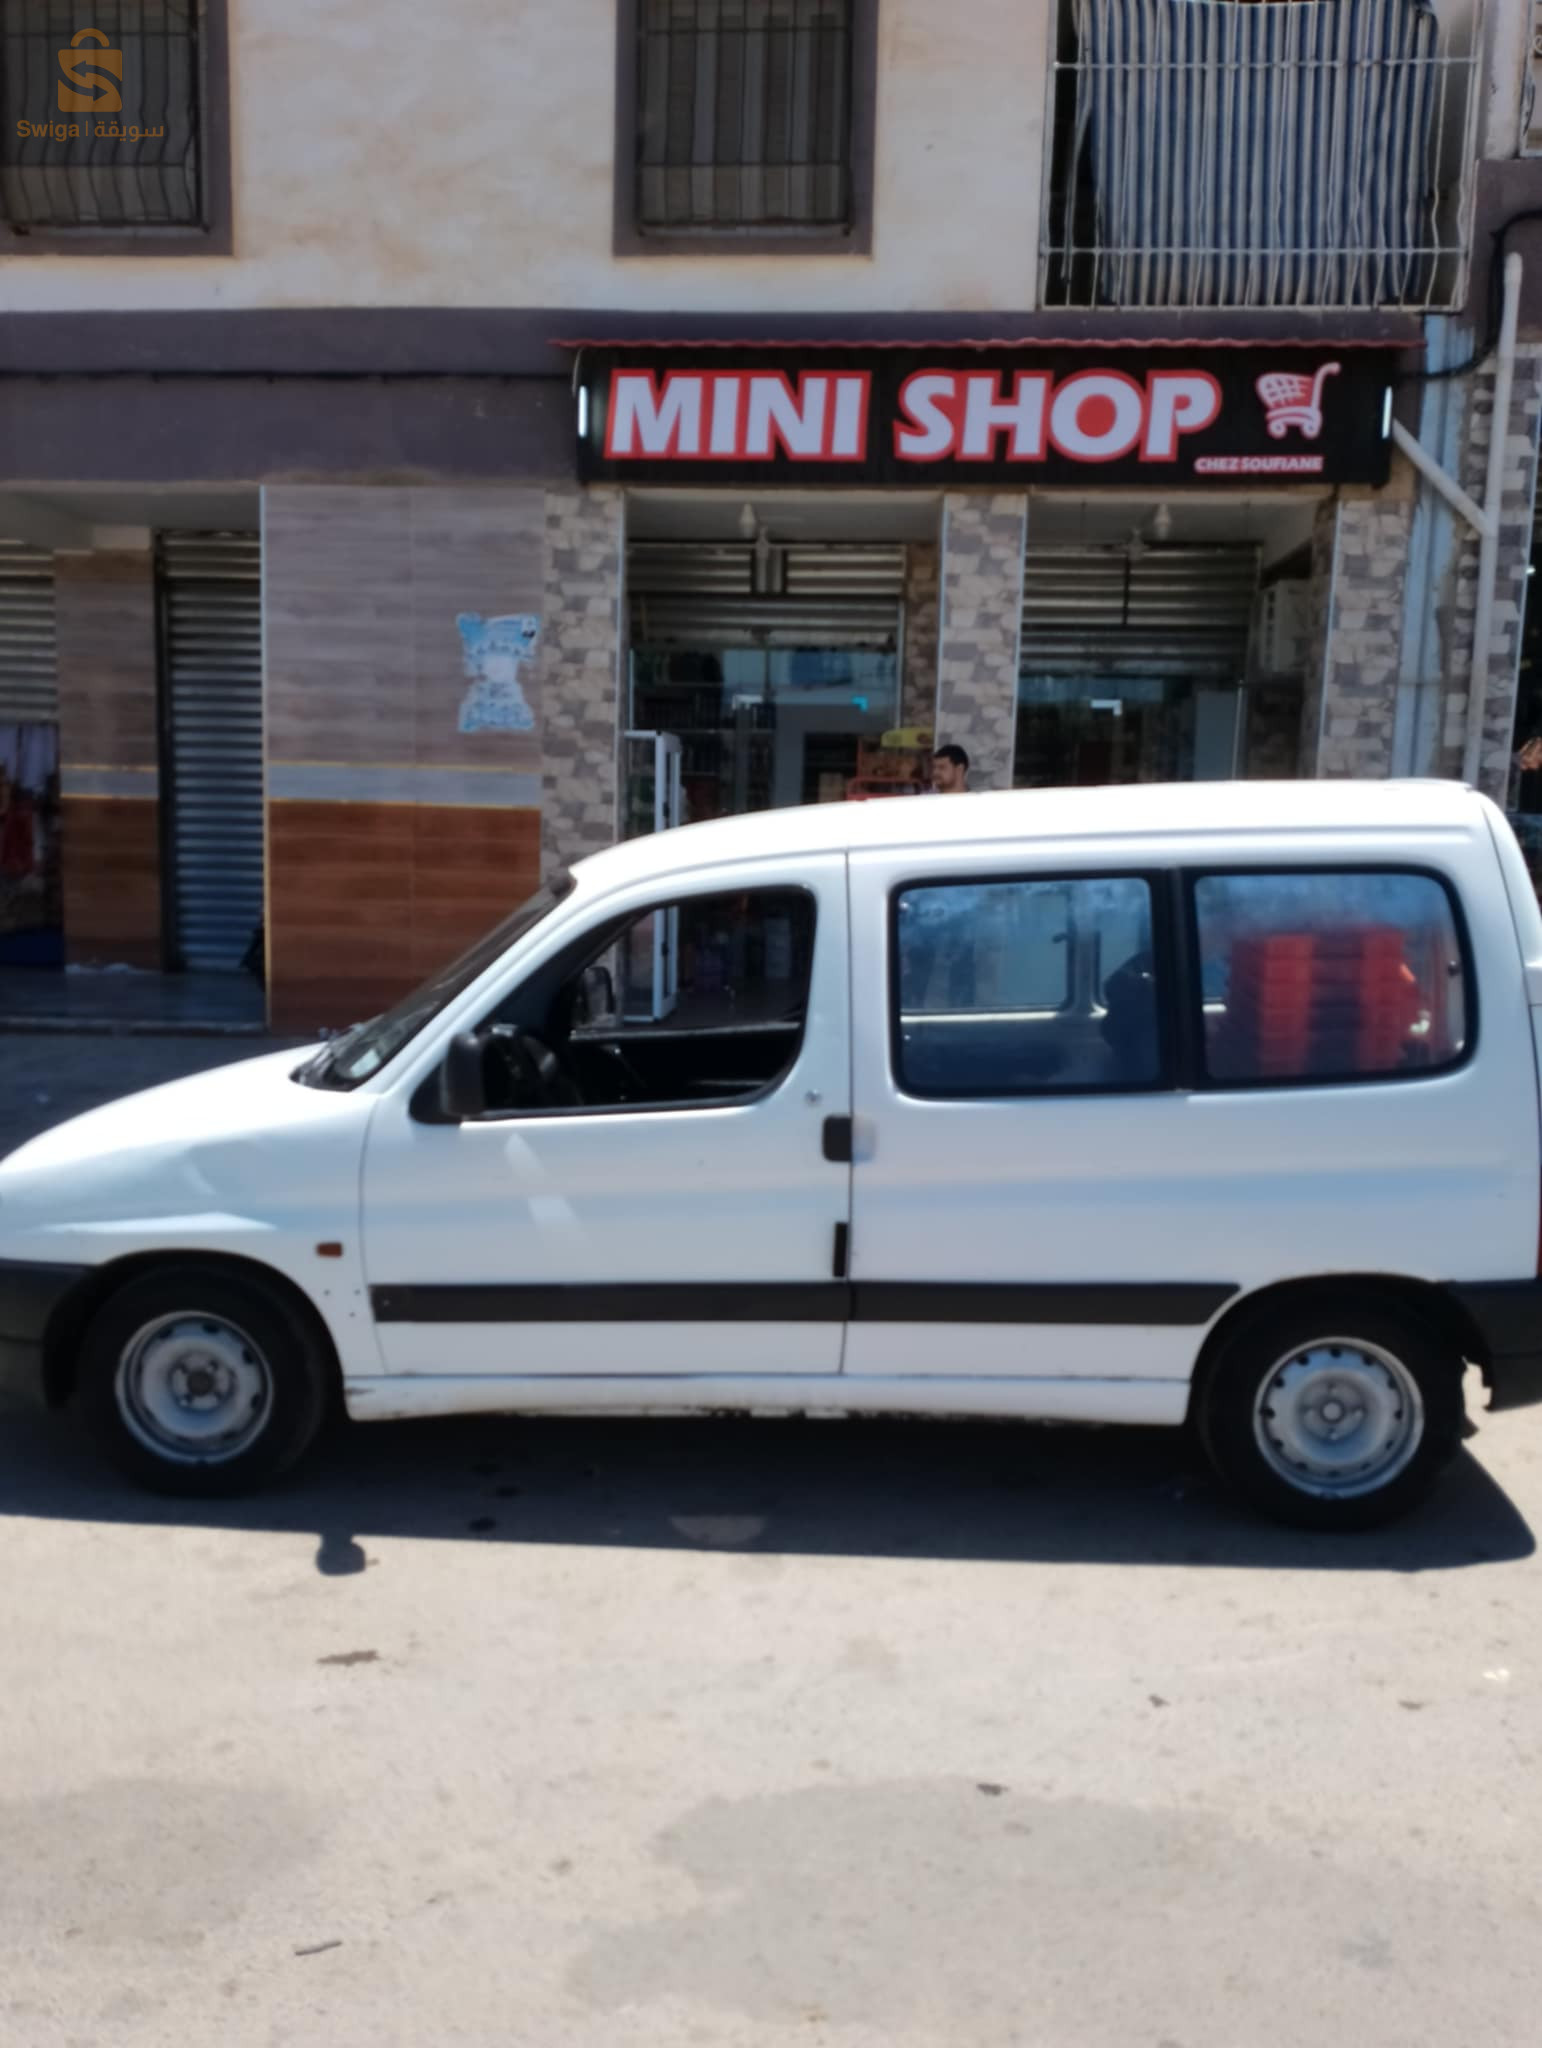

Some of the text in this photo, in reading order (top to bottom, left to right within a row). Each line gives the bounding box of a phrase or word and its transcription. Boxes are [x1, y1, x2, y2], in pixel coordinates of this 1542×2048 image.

[606, 370, 1220, 460] MINI SHOP
[1194, 455, 1324, 473] CHEZ SOUFIANE
